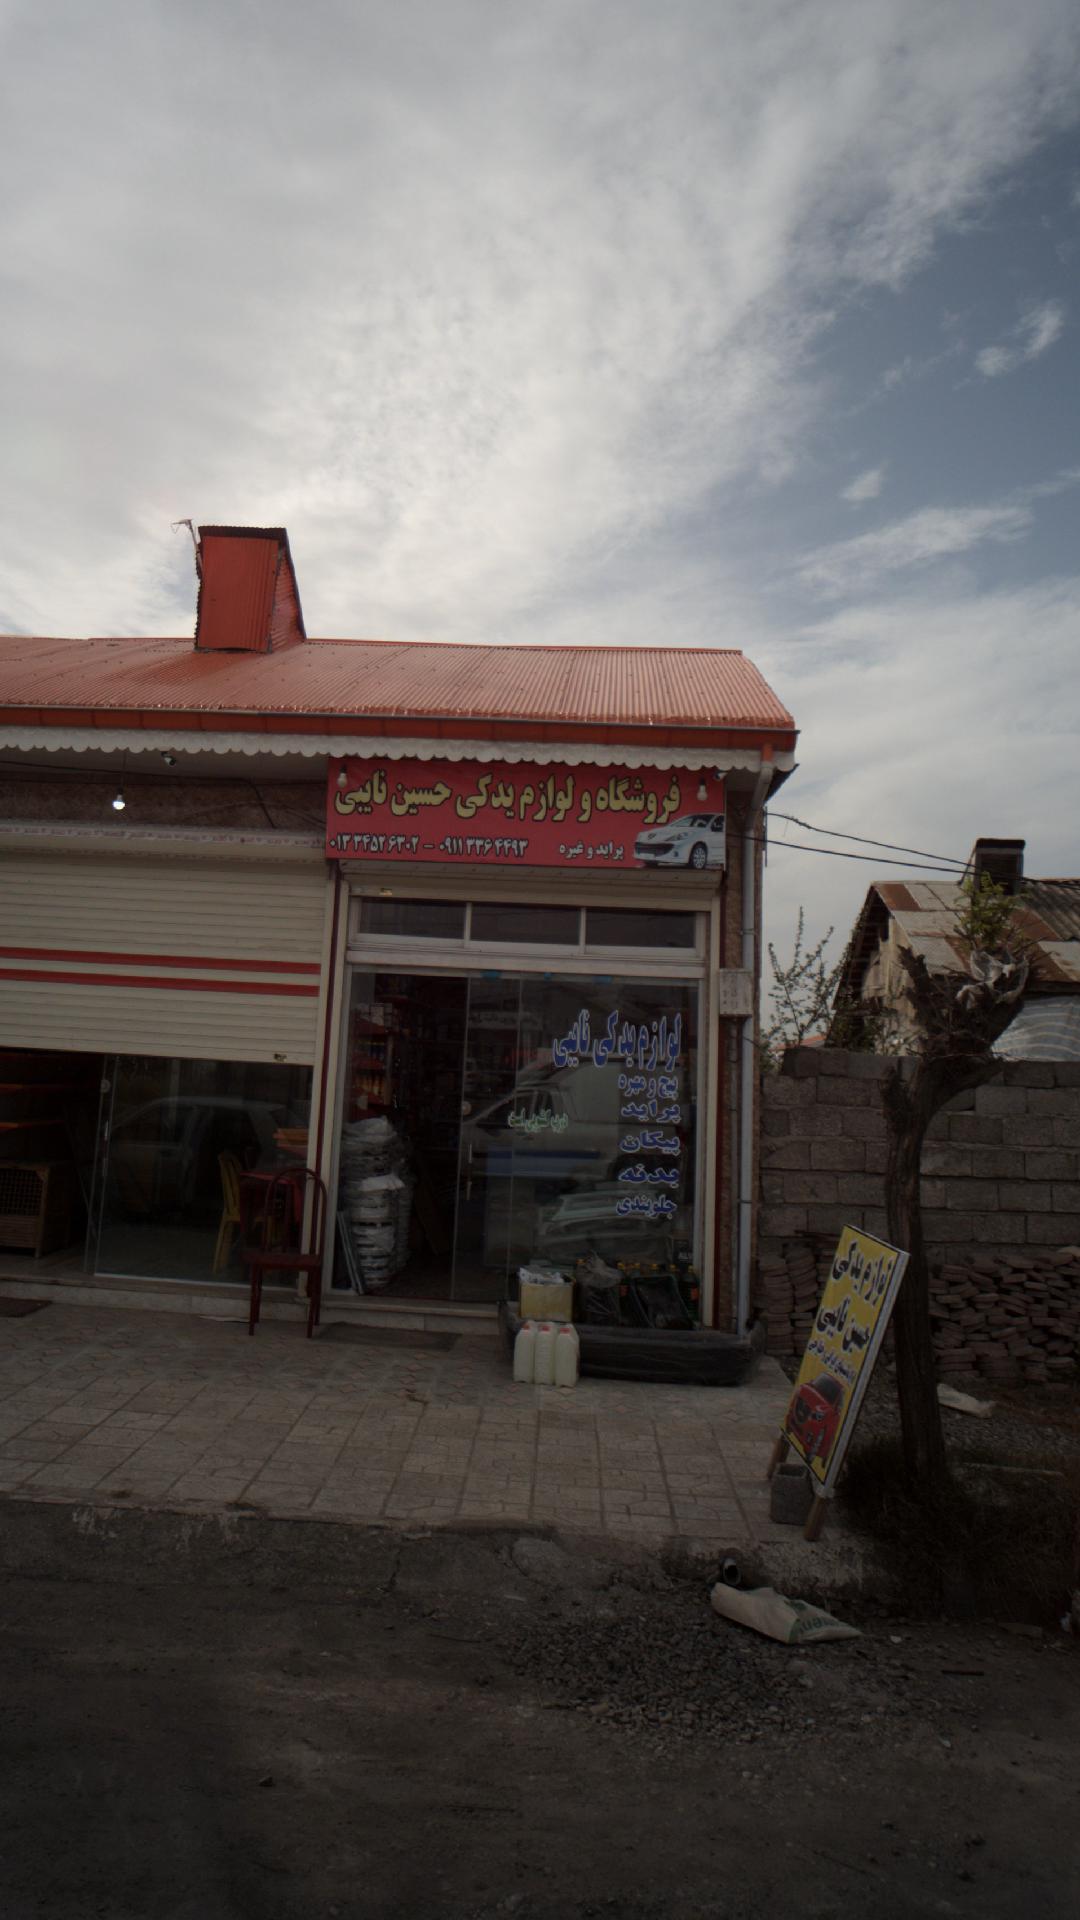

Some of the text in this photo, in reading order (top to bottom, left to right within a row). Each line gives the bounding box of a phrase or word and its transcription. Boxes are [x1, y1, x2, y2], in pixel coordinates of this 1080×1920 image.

[391, 782, 452, 816] حسین
[456, 773, 515, 818] یدکی
[519, 774, 575, 821] لوازم
[577, 790, 592, 822] و
[595, 775, 681, 824] فروشگاه
[559, 841, 624, 860] پراید و غیره
[638, 1012, 682, 1072] لوازم
[618, 1074, 678, 1101] پیچ و مهره
[621, 1099, 681, 1124] پراید
[619, 1130, 681, 1156] پیکان
[618, 1164, 680, 1188] بدنه
[832, 1240, 893, 1306] لوازم یدکی
